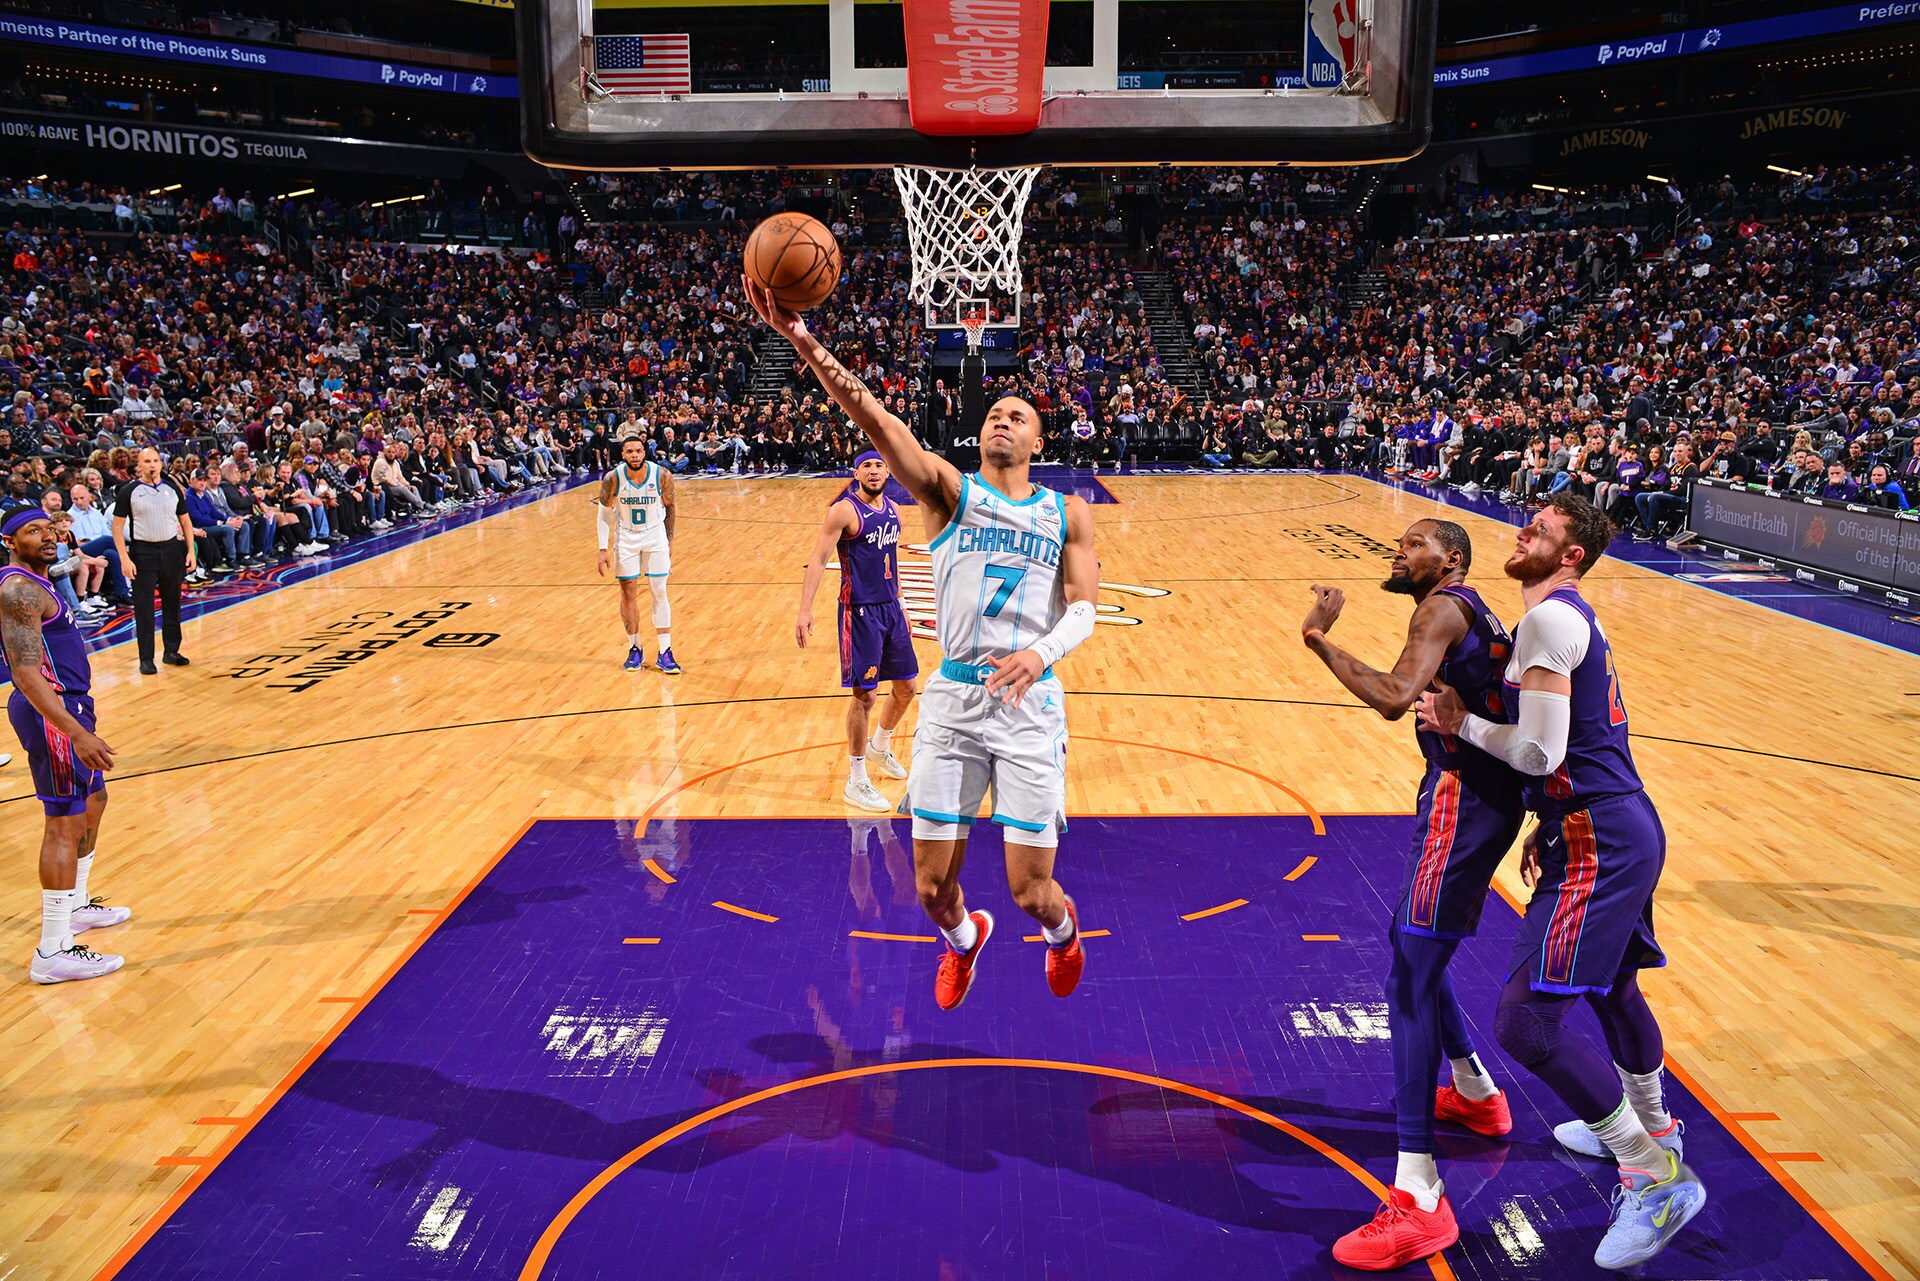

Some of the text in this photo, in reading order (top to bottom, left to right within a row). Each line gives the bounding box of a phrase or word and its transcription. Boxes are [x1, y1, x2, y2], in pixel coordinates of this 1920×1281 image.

[1859, 2, 1920, 21] Preferr
[58, 26, 118, 46] Partner
[121, 36, 137, 48] of
[140, 38, 165, 53] the
[169, 41, 228, 61] Phoenix
[231, 48, 267, 64] Suns
[1617, 40, 1666, 58] PayPal
[399, 69, 443, 87] PayPal
[802, 78, 831, 93] sun
[1260, 75, 1268, 86] 9
[1312, 63, 1336, 81] NBA
[1461, 66, 1489, 80] Suns
[1740, 106, 1846, 140] JAMESON
[39, 125, 79, 141] AGAVE
[85, 123, 239, 158] HORNITOS
[244, 142, 308, 159] TEQUILA
[1559, 128, 1648, 157] JAMESON
[620, 496, 657, 505] CHARLOTTE
[631, 508, 646, 525] 0
[1715, 504, 1788, 537] Banner Health
[958, 528, 1061, 568] CHARLOTTE
[1837, 520, 1920, 551] Official Health
[883, 552, 893, 580] 1
[1856, 549, 1872, 564] of
[1870, 550, 1889, 569] the
[982, 564, 1026, 618] 7
[210, 610, 395, 679] CENTER
[264, 601, 473, 693] FOOTPRINT
